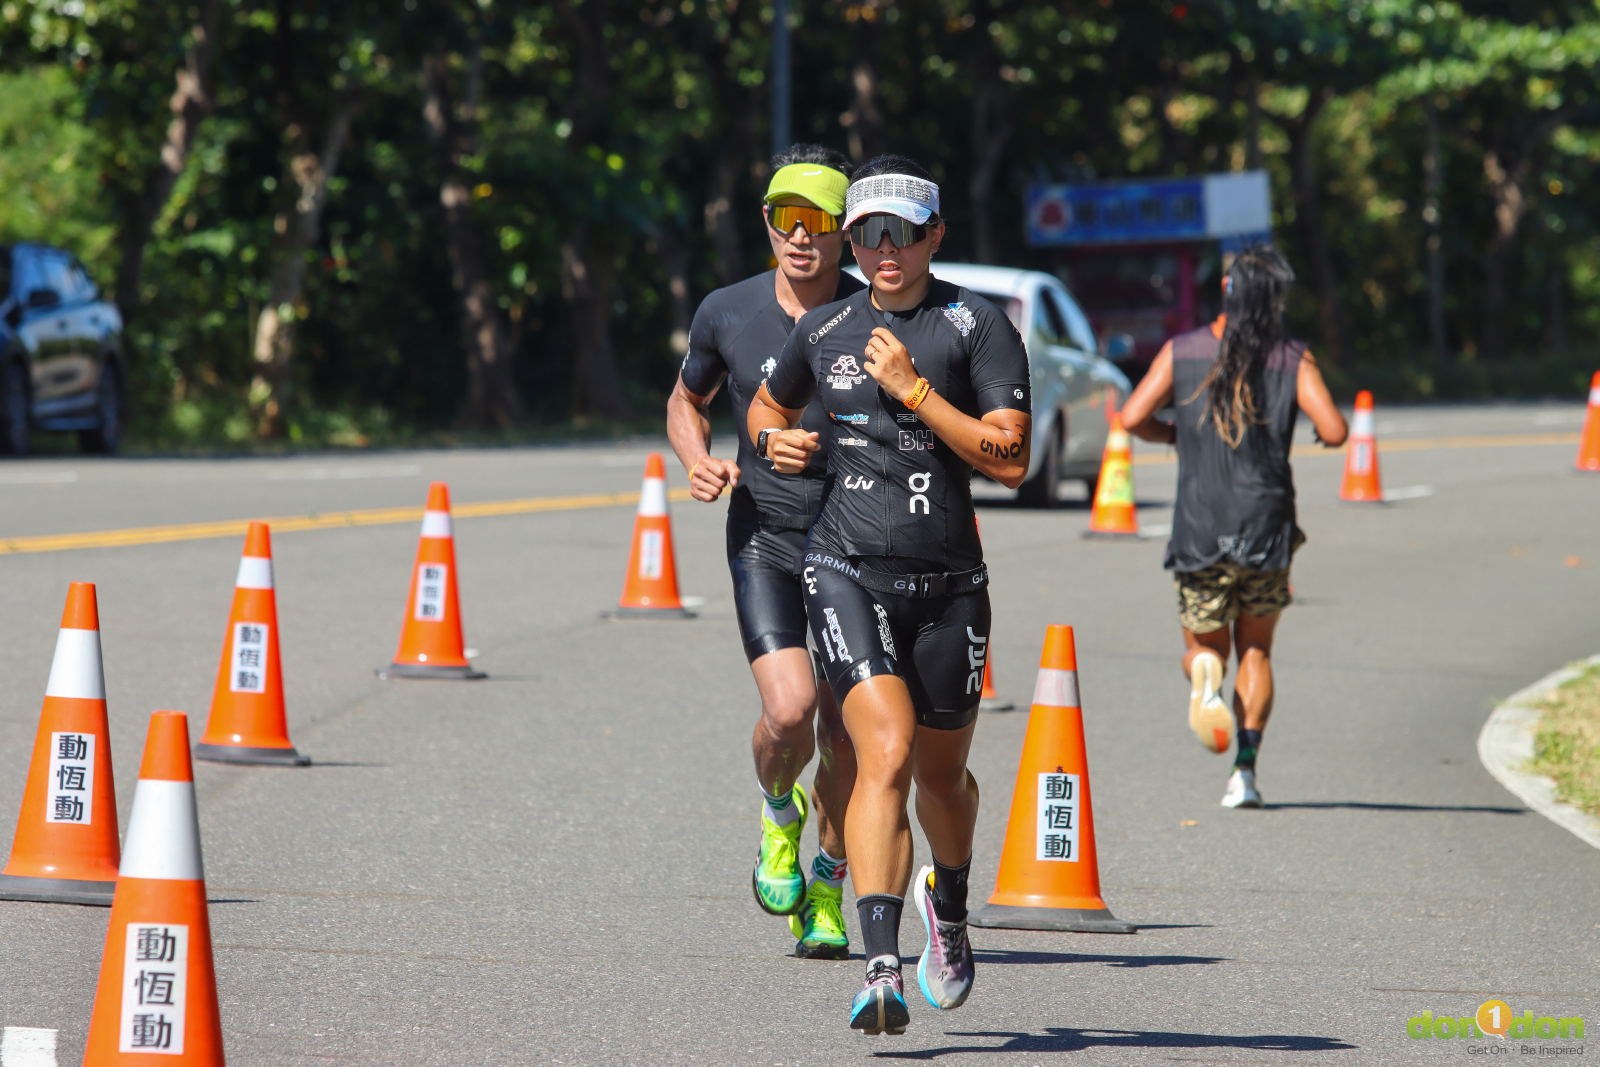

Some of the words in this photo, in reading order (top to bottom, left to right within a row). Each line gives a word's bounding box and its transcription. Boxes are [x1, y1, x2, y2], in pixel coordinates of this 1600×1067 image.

[818, 305, 852, 337] SUNSTAR
[804, 553, 862, 579] GARMIN
[53, 734, 87, 822] 動恆動
[1044, 775, 1073, 859] 動恆動
[131, 927, 176, 1050] 動恆動
